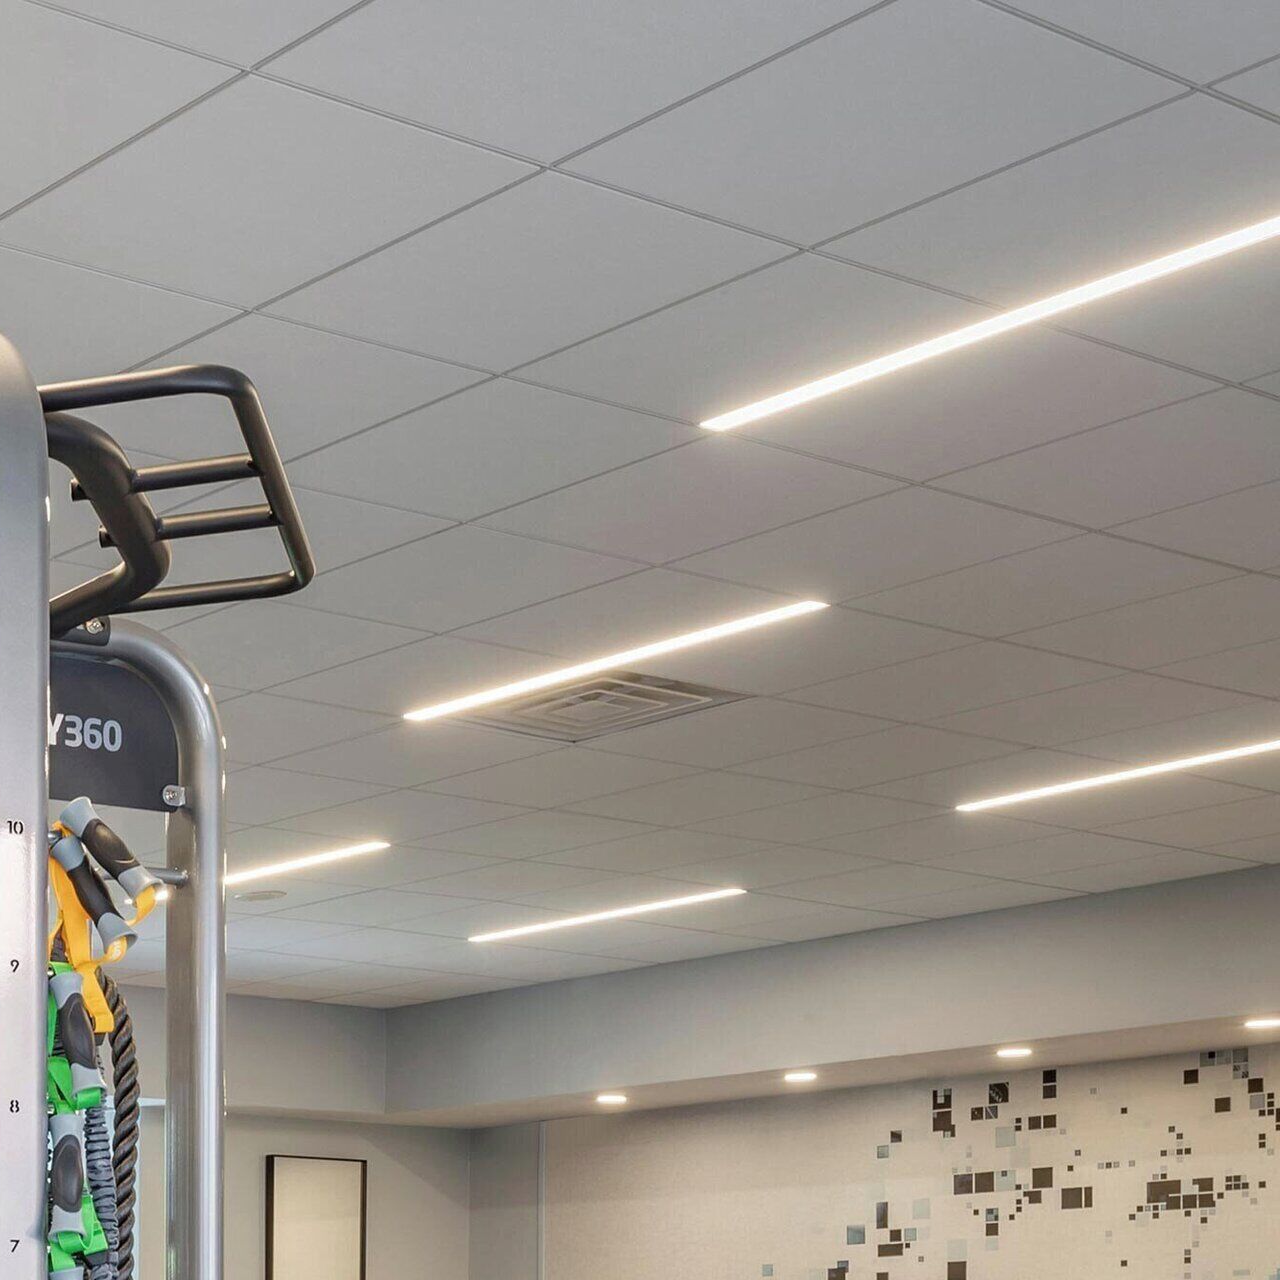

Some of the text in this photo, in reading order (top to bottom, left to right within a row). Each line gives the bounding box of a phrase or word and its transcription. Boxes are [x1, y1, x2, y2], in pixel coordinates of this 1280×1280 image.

[6, 820, 24, 835] 10
[10, 959, 20, 973] 9
[9, 1099, 20, 1114] 8
[10, 1239, 20, 1253] 7
